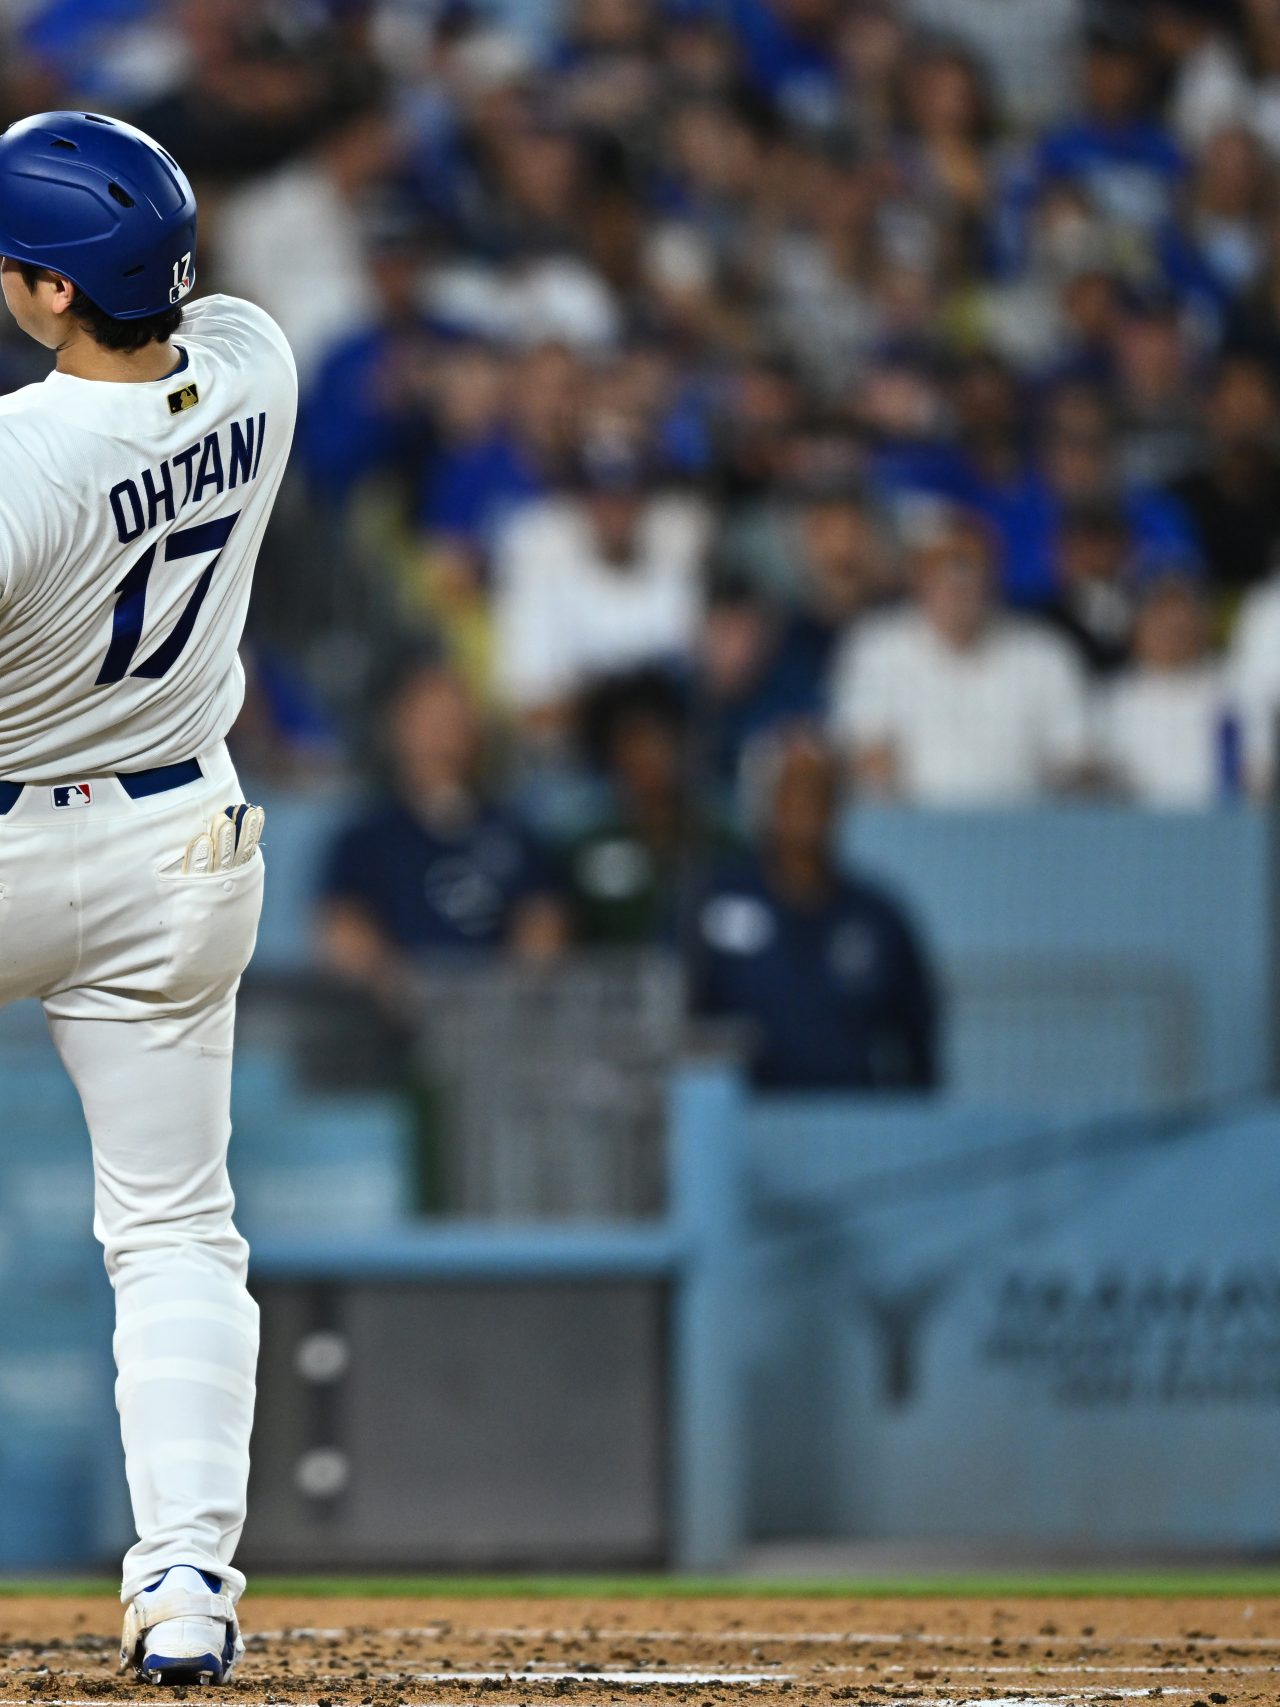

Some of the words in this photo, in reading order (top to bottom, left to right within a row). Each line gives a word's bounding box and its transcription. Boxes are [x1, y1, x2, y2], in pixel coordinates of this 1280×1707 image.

[173, 251, 191, 286] 17
[109, 412, 267, 545] OHTANI
[94, 509, 242, 686] 17
